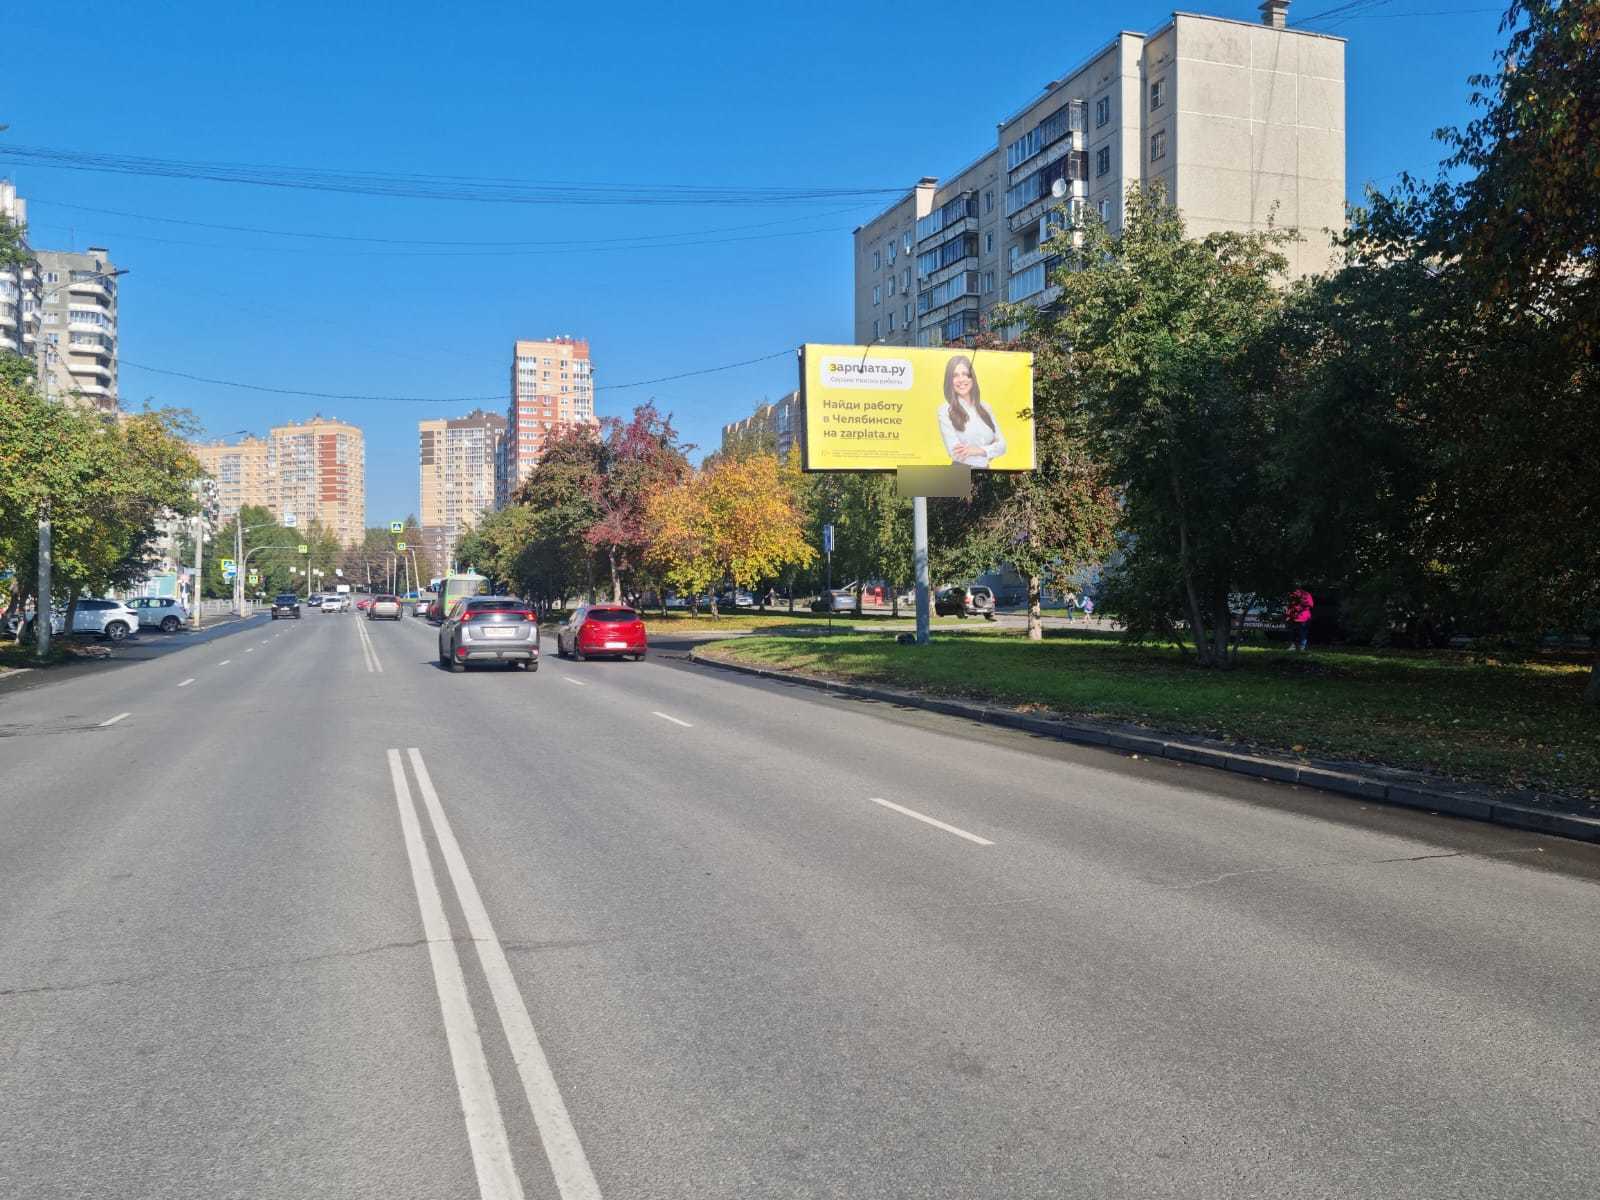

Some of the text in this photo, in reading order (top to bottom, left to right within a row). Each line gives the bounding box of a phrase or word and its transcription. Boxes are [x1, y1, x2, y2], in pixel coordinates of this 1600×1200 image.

[823, 399, 903, 413] Найди работу
[823, 414, 903, 425] в Челябинске
[823, 429, 900, 440] на zarplata.ru
